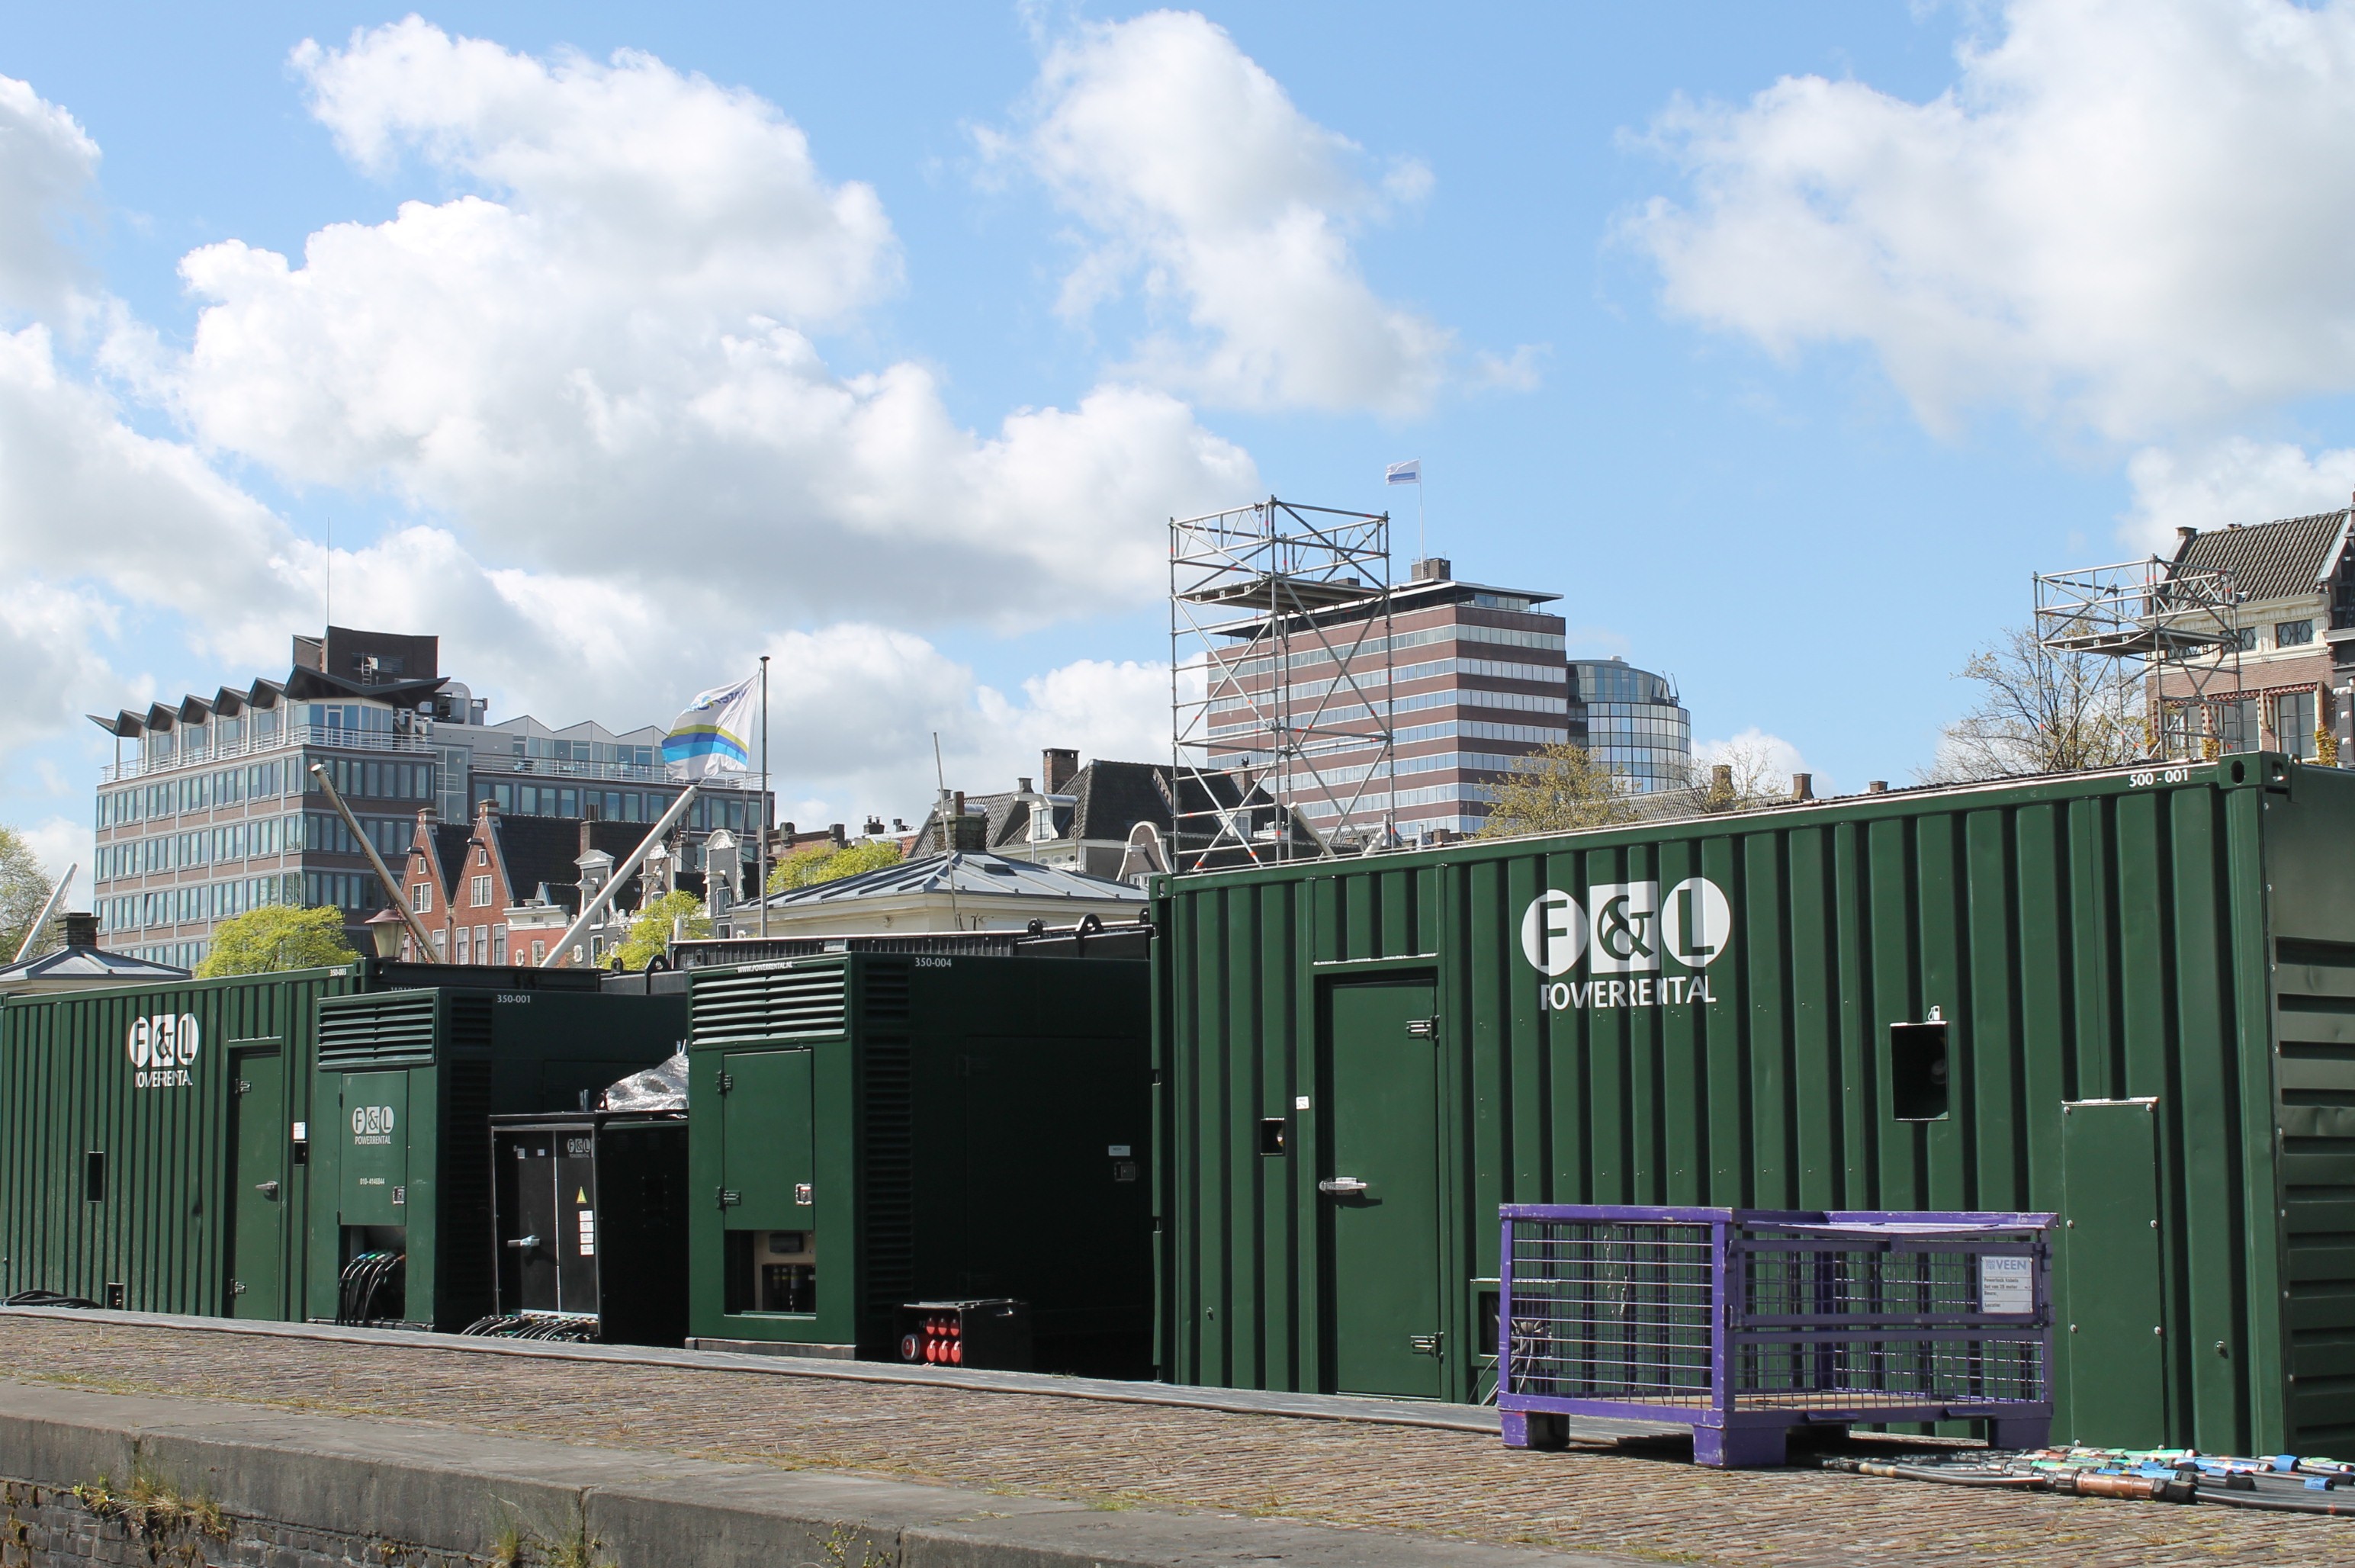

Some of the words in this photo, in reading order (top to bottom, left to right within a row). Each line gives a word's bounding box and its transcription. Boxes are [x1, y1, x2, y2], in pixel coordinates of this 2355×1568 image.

[2128, 773, 2154, 788] 500
[2164, 768, 2188, 783] 001
[1533, 885, 1720, 969] F&L
[915, 957, 952, 967] 350-004
[497, 994, 531, 1003] 350-001
[355, 1109, 392, 1131] F&L
[355, 1136, 391, 1145] POWERRENTAL
[1996, 1259, 2027, 1271] VEEN
